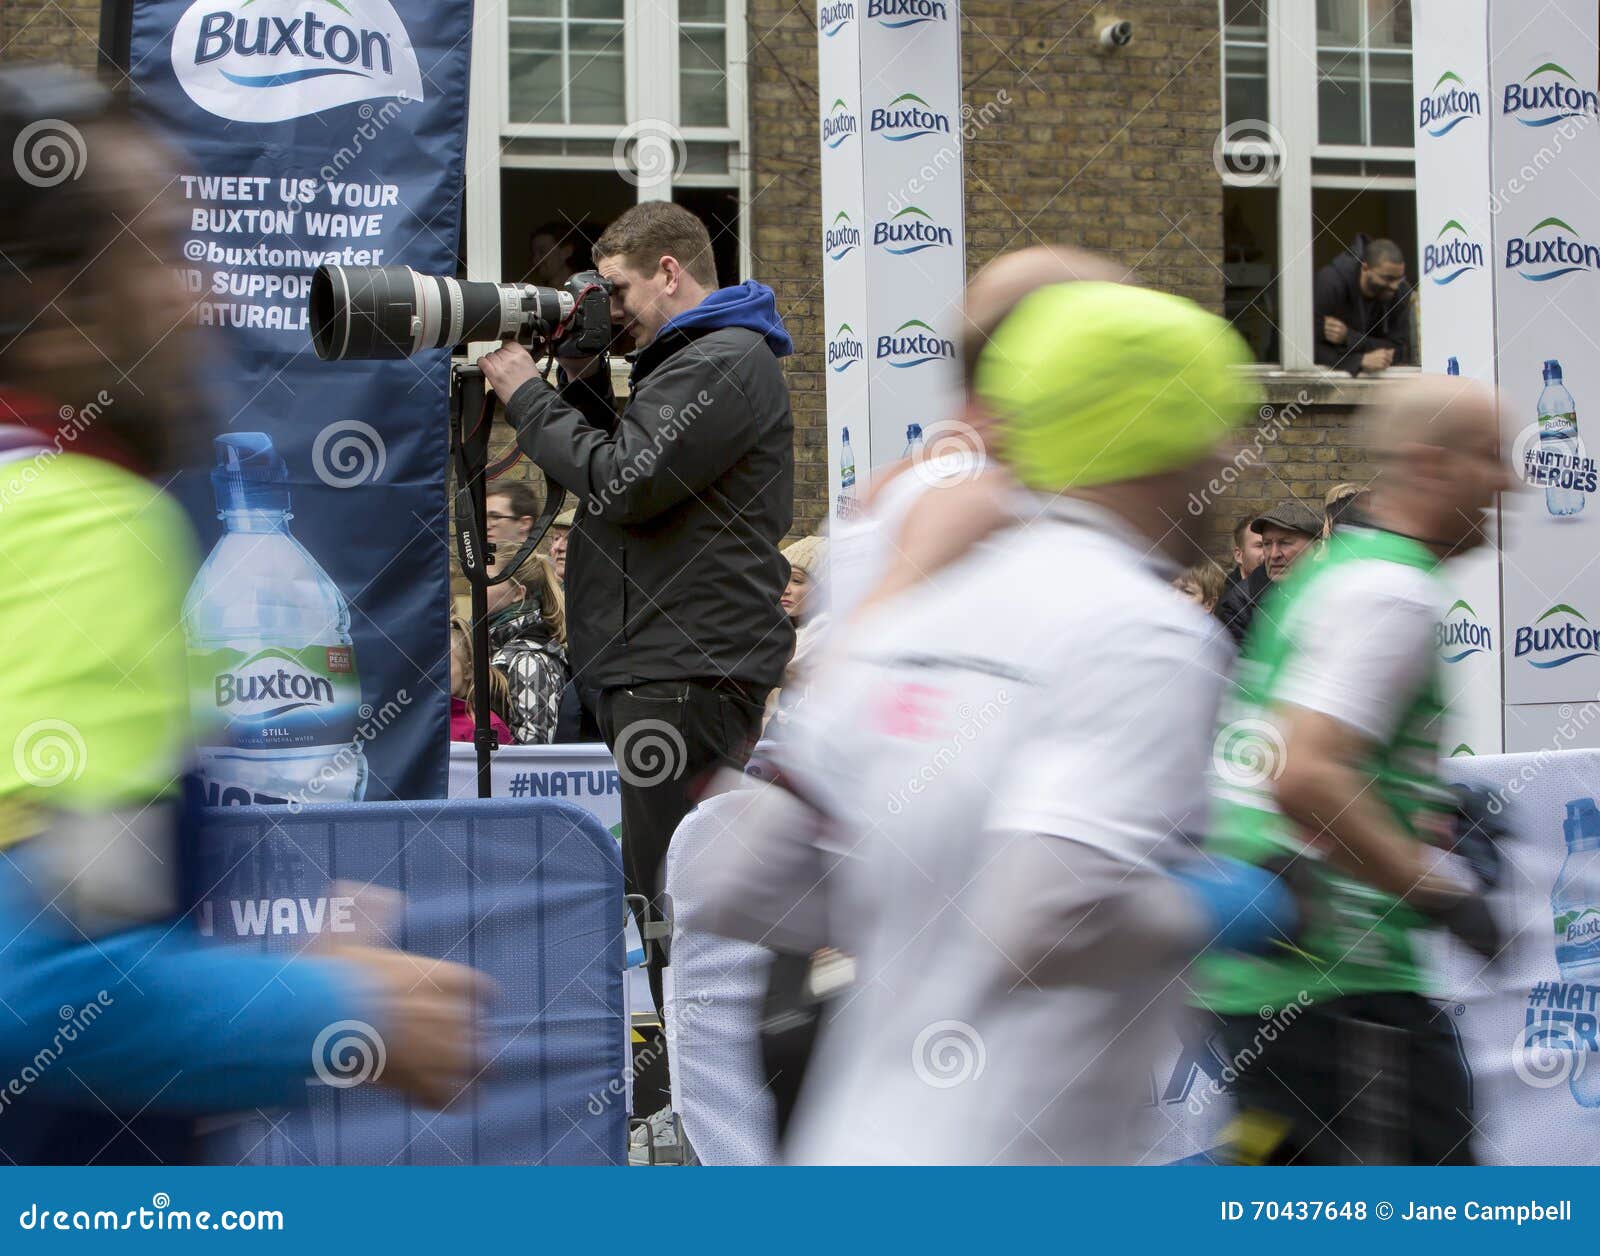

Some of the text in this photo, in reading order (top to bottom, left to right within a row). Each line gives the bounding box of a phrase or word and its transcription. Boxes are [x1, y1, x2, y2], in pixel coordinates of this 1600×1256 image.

[821, 0, 854, 30] Buxton
[868, 0, 947, 20] Buxton
[194, 11, 393, 75] Buxton
[1420, 86, 1481, 128] Buxton
[1503, 82, 1598, 114] Buxton
[824, 113, 856, 142] Buxton
[871, 108, 949, 132] Buxton
[180, 175, 399, 208] TWEET US YOUR
[191, 209, 383, 238] BUXTON WAVE
[826, 225, 860, 252] Buxton
[874, 221, 952, 245] Buxton
[184, 240, 384, 268] @buxtonwater
[1424, 236, 1483, 275] Buxton
[175, 268, 312, 299] ND SUPPOR
[829, 337, 863, 364] Buxton
[877, 334, 955, 359] Buxton
[1525, 449, 1597, 473] #NATURAL
[1524, 463, 1597, 493] HEROES
[463, 531, 475, 569] Canon
[1434, 618, 1492, 651] Buxton
[215, 669, 335, 707] Buxton
[262, 728, 289, 737] STILL
[508, 770, 620, 797] #NATUR
[230, 897, 355, 936] WAVE
[1567, 918, 1600, 942] Buxt
[1528, 980, 1600, 1012] #NAT
[1525, 1008, 1600, 1052] HER
